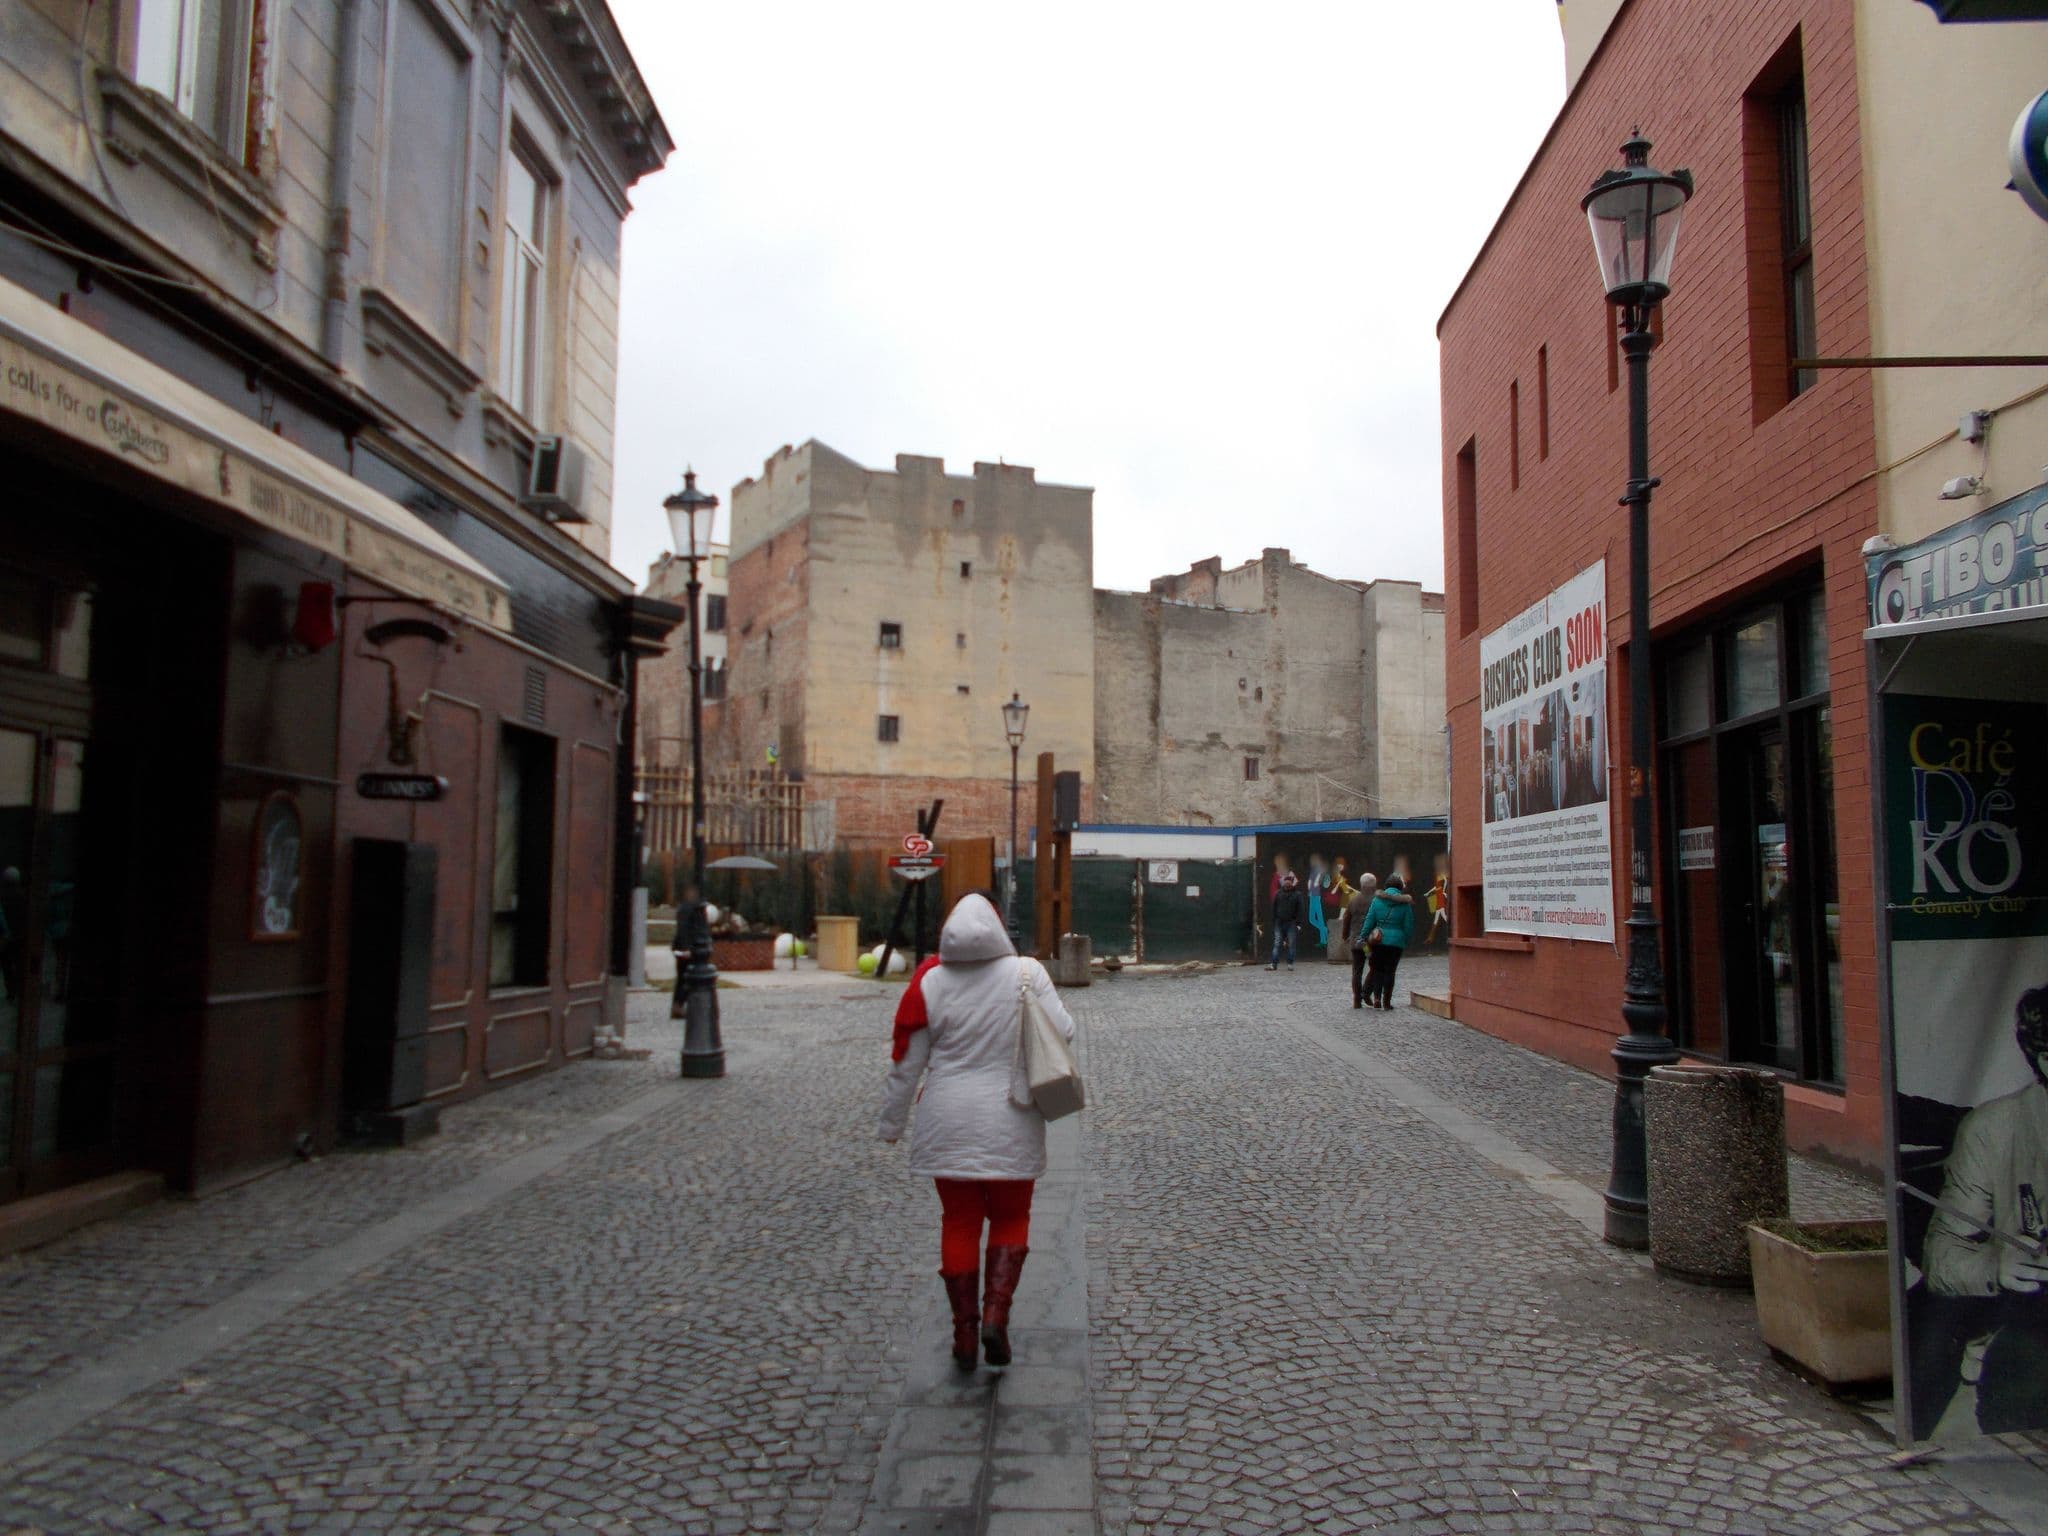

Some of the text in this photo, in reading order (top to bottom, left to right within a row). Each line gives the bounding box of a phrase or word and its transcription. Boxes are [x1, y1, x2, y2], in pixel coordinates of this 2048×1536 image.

[7, 365, 50, 401] calls
[55, 383, 82, 414] for
[86, 405, 97, 422] a
[100, 399, 171, 465] Carlsberg
[1483, 600, 1603, 713] BUSINESS CLUB SOON
[1909, 721, 2016, 777] Café
[1909, 819, 2023, 894] KO
[1911, 895, 2026, 919] Comedy Club
